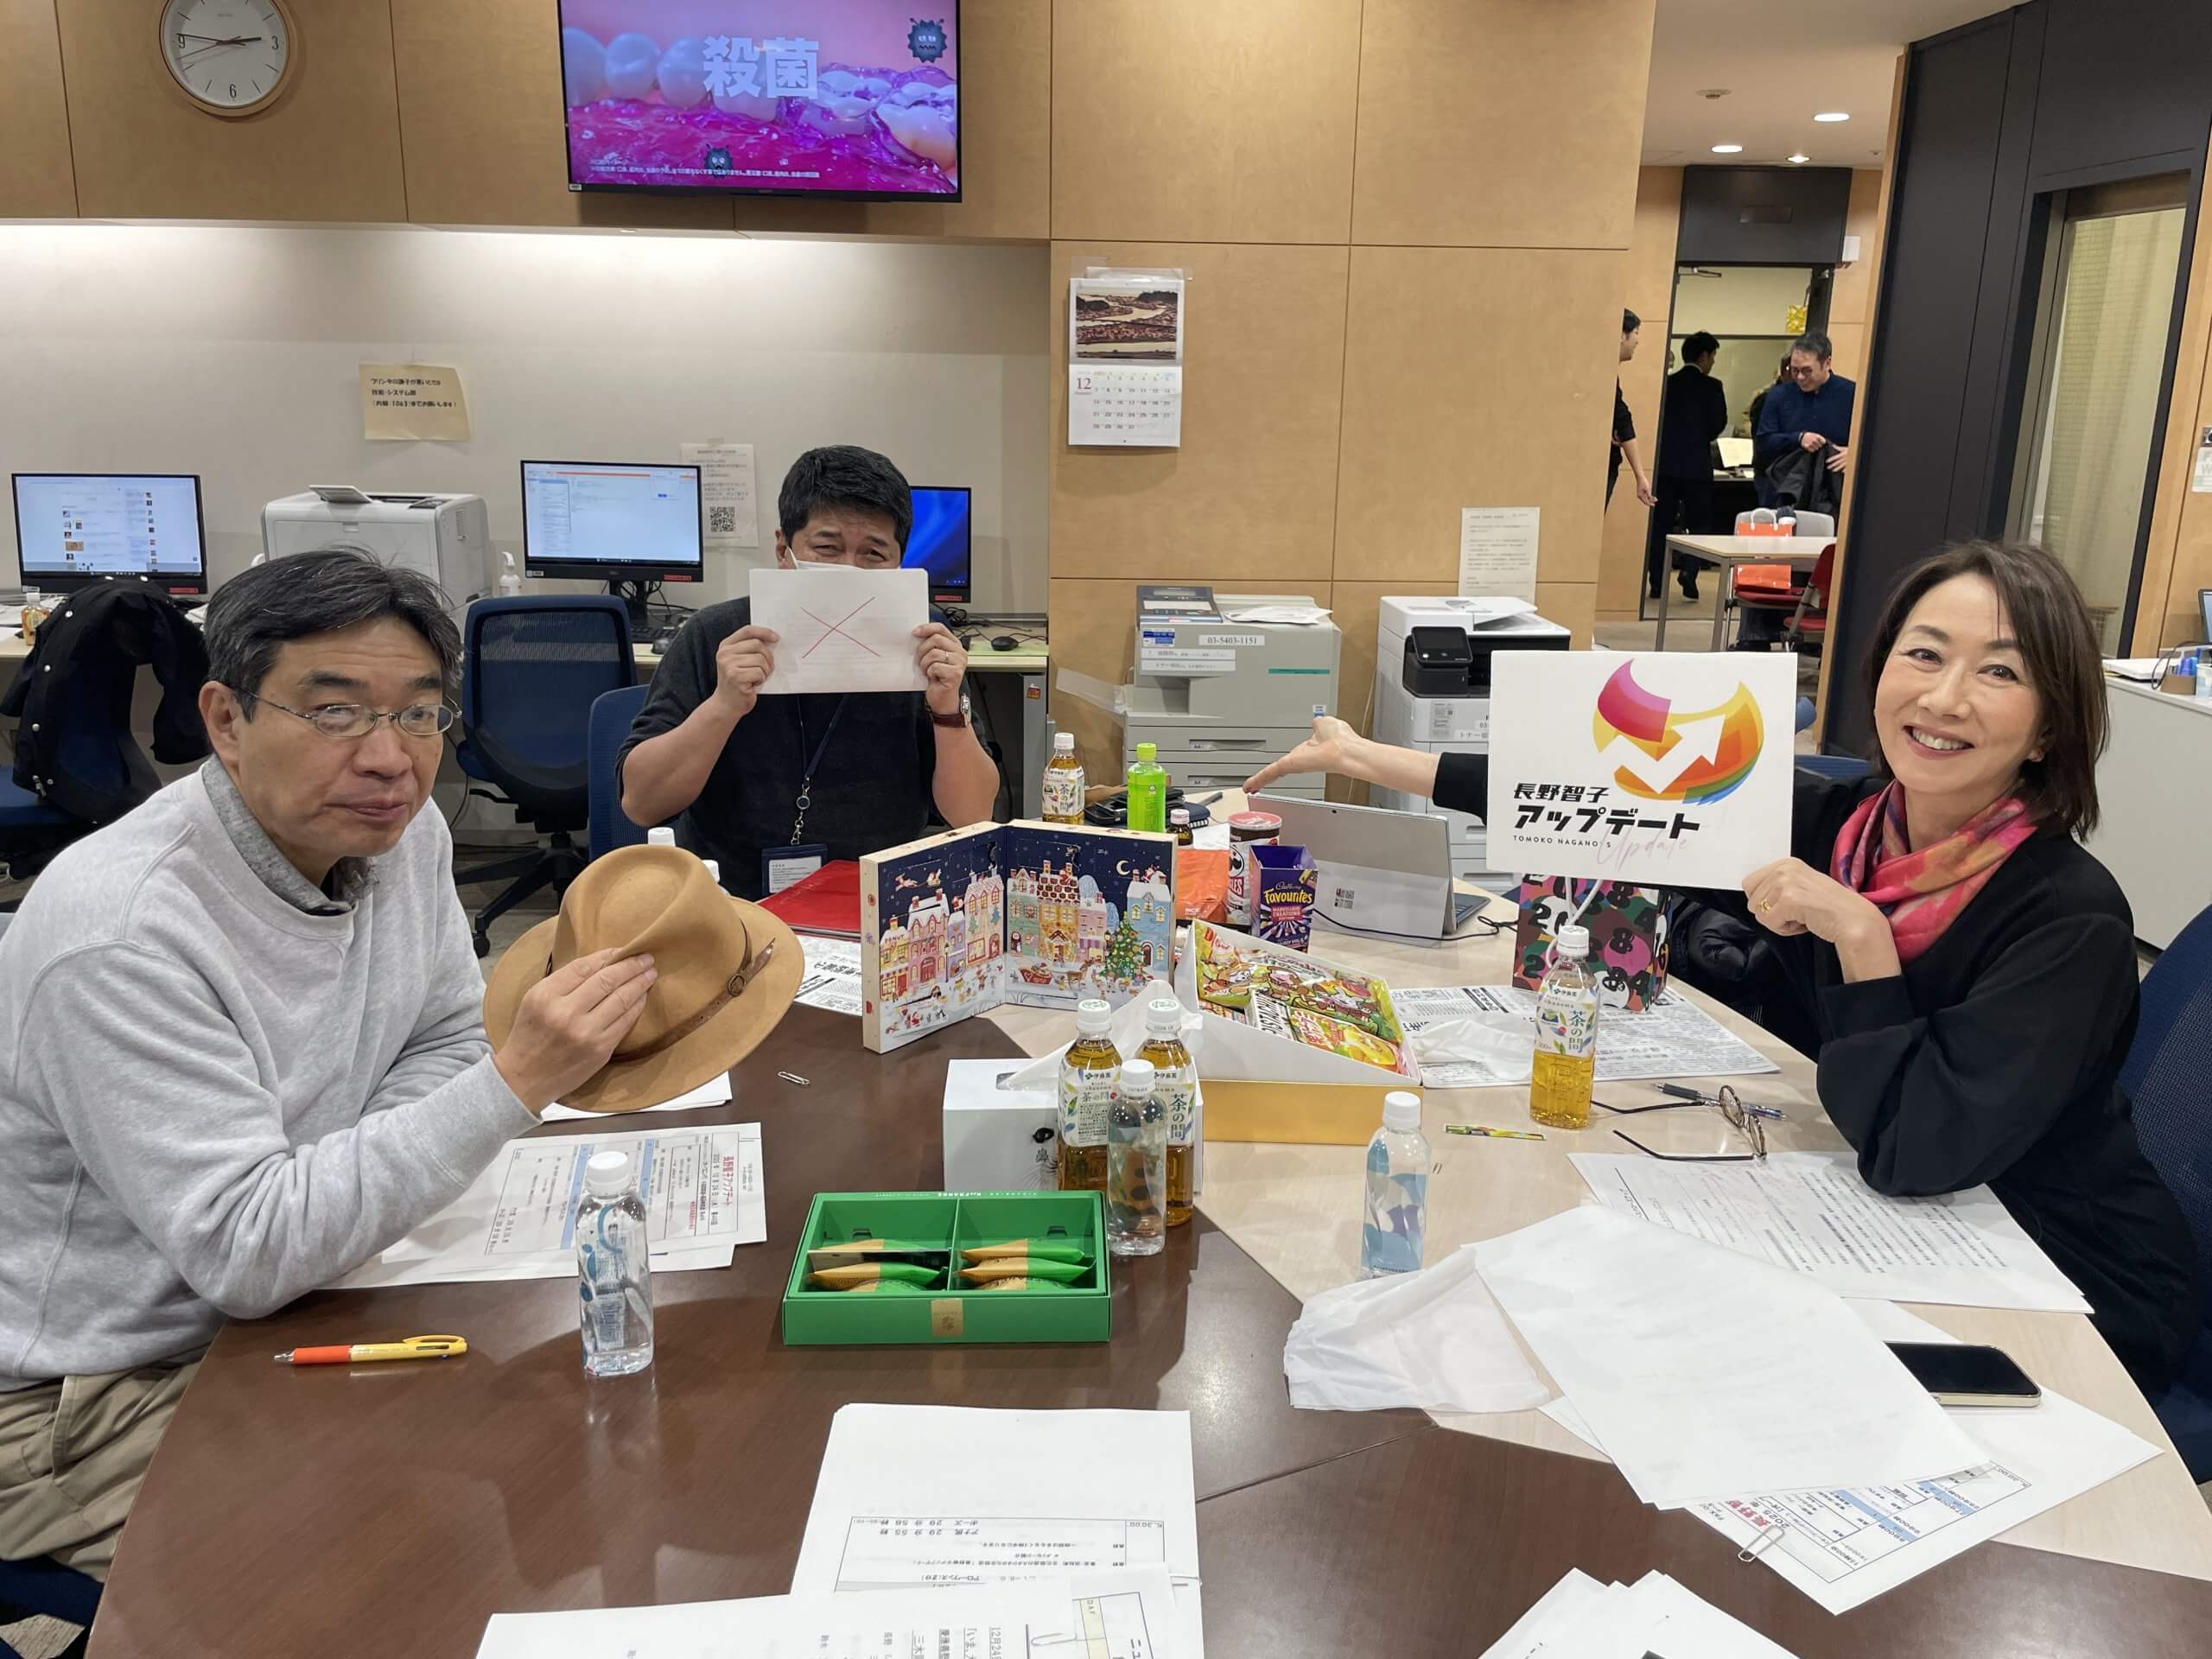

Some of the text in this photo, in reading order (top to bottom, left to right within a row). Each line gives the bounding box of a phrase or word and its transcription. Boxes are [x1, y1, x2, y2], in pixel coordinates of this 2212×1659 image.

[270, 35, 279, 50] 3
[702, 34, 819, 100] 殺菌
[229, 84, 237, 99] 6
[1077, 378, 1092, 390] 12
[1207, 636, 1258, 645] 03-5403-1151
[1513, 782, 1610, 803] 長野智子
[1514, 804, 1700, 840] アップデート
[1513, 835, 1553, 845] TOMOKO
[1263, 888, 1313, 905] Favourites
[1569, 1009, 1586, 1053] 茶の間
[1081, 1091, 1109, 1103] 茶の間
[1169, 1093, 1189, 1141] 茶の間
